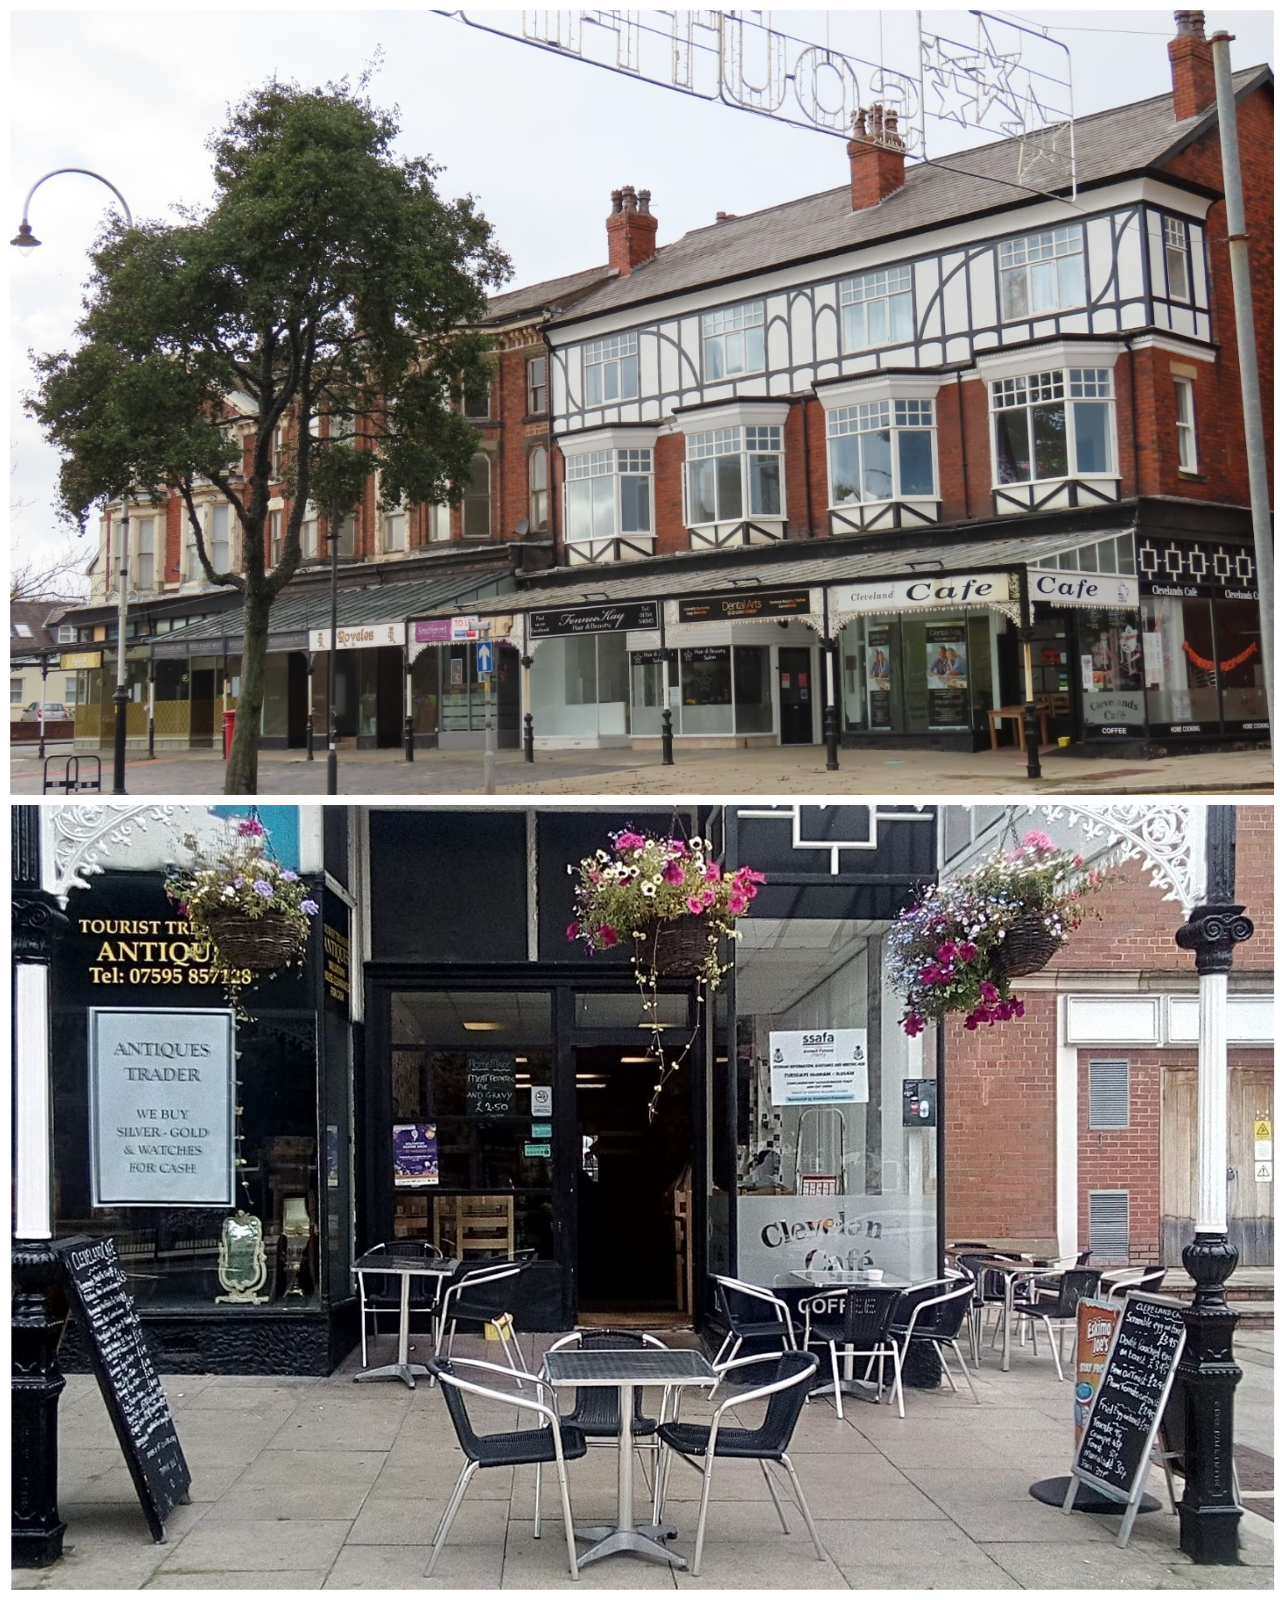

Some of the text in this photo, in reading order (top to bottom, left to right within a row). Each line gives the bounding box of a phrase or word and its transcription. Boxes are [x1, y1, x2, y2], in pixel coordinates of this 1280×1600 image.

[850, 579, 993, 602] Cleveland Cafe
[1036, 576, 1098, 599] Cafe
[1152, 585, 1183, 596] Clevelands
[722, 599, 762, 611] Dental Arts
[454, 619, 463, 627] TO
[337, 628, 375, 647] Royales
[79, 919, 161, 934] TOURIST
[96, 941, 216, 967] ANTIQU
[89, 967, 124, 984] Tel:
[129, 968, 183, 984] 07595
[802, 1032, 834, 1043] ssafa
[114, 1042, 211, 1059] ANTIQUES
[124, 1067, 201, 1082] TRADER
[467, 1091, 513, 1100] AND GRAVY
[137, 1109, 189, 1120] WE BUY
[116, 1127, 160, 1138] SILVER
[170, 1127, 211, 1138] GOLD
[123, 1145, 204, 1156] & WATCHES
[129, 1163, 197, 1174] FOR CASH
